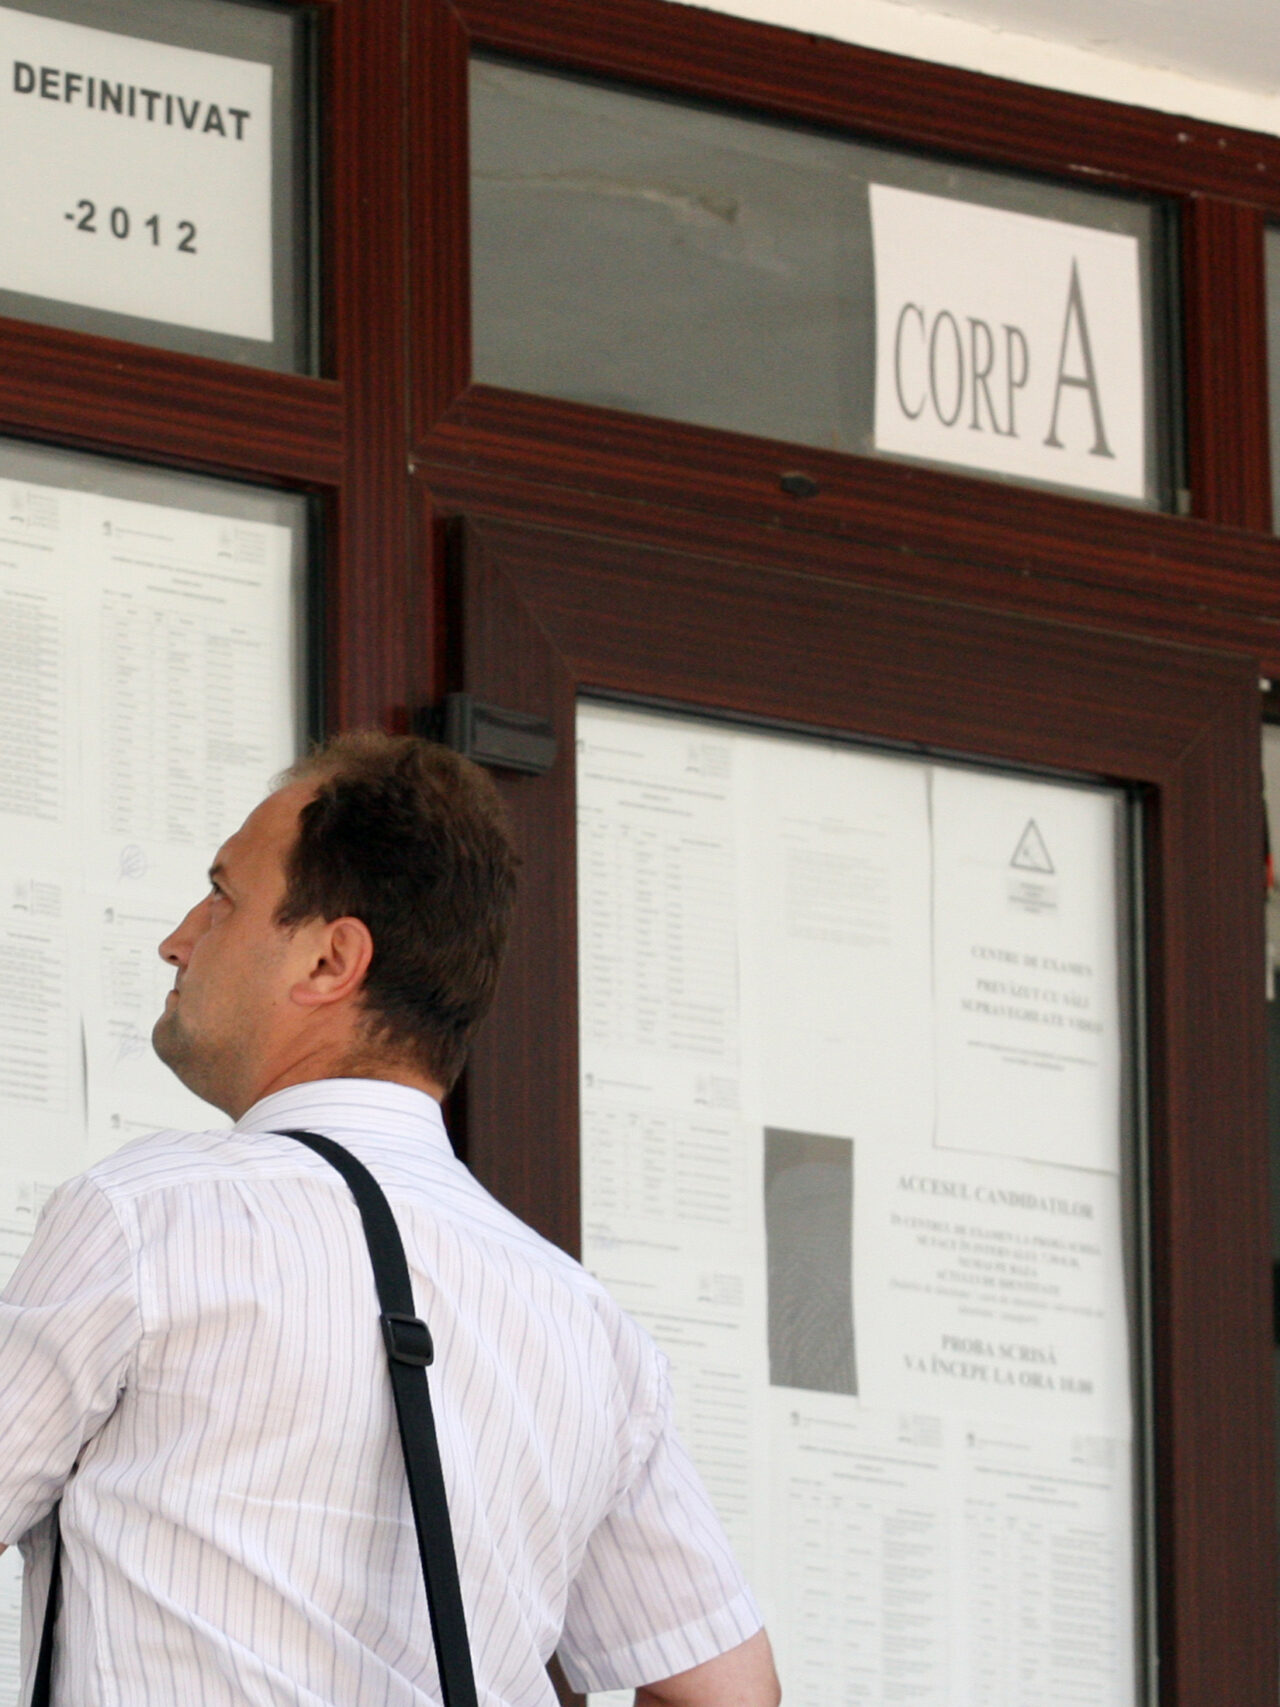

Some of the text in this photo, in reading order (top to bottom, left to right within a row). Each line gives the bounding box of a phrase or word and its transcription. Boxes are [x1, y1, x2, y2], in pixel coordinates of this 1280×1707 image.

[13, 61, 251, 141] DEFINITIVAT
[893, 255, 1116, 459] CORP A
[897, 1175, 970, 1201] ACCESUL
[940, 1334, 994, 1357] PROBA
